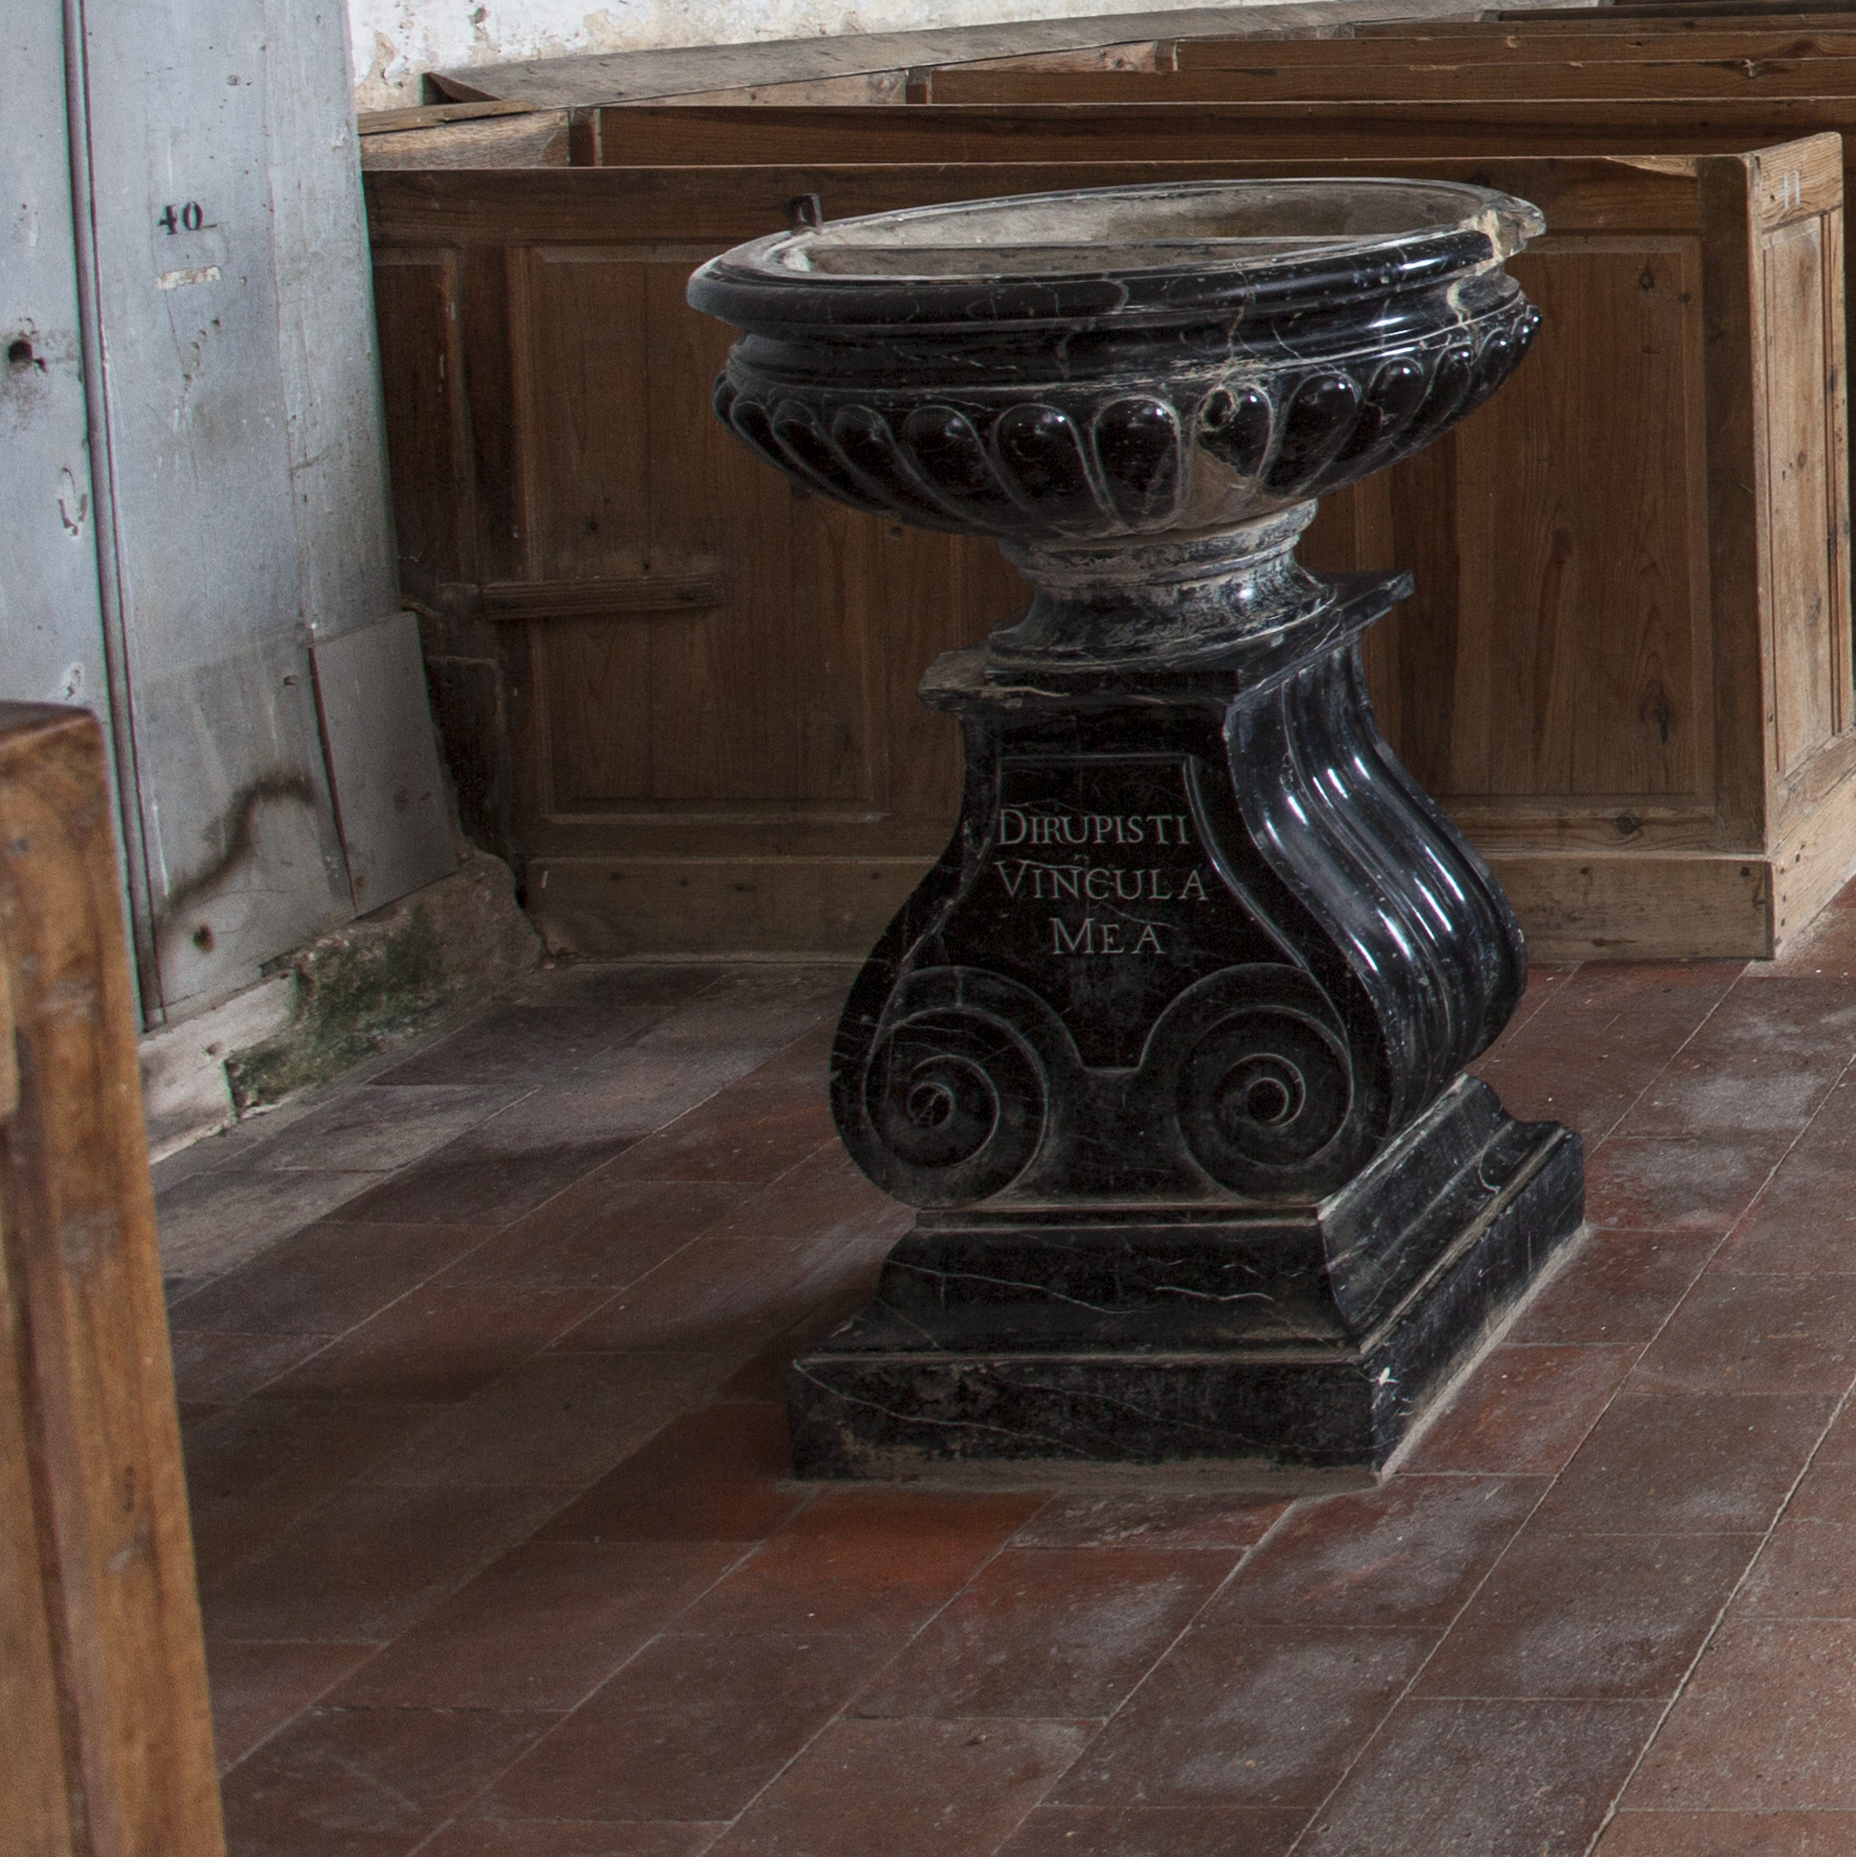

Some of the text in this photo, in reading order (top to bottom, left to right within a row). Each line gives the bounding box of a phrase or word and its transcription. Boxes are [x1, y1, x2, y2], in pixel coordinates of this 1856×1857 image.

[157, 201, 203, 235] 40
[997, 809, 1191, 846] DIRUPISTI
[994, 860, 1209, 902] VINCULA
[1049, 917, 1167, 955] MEA
